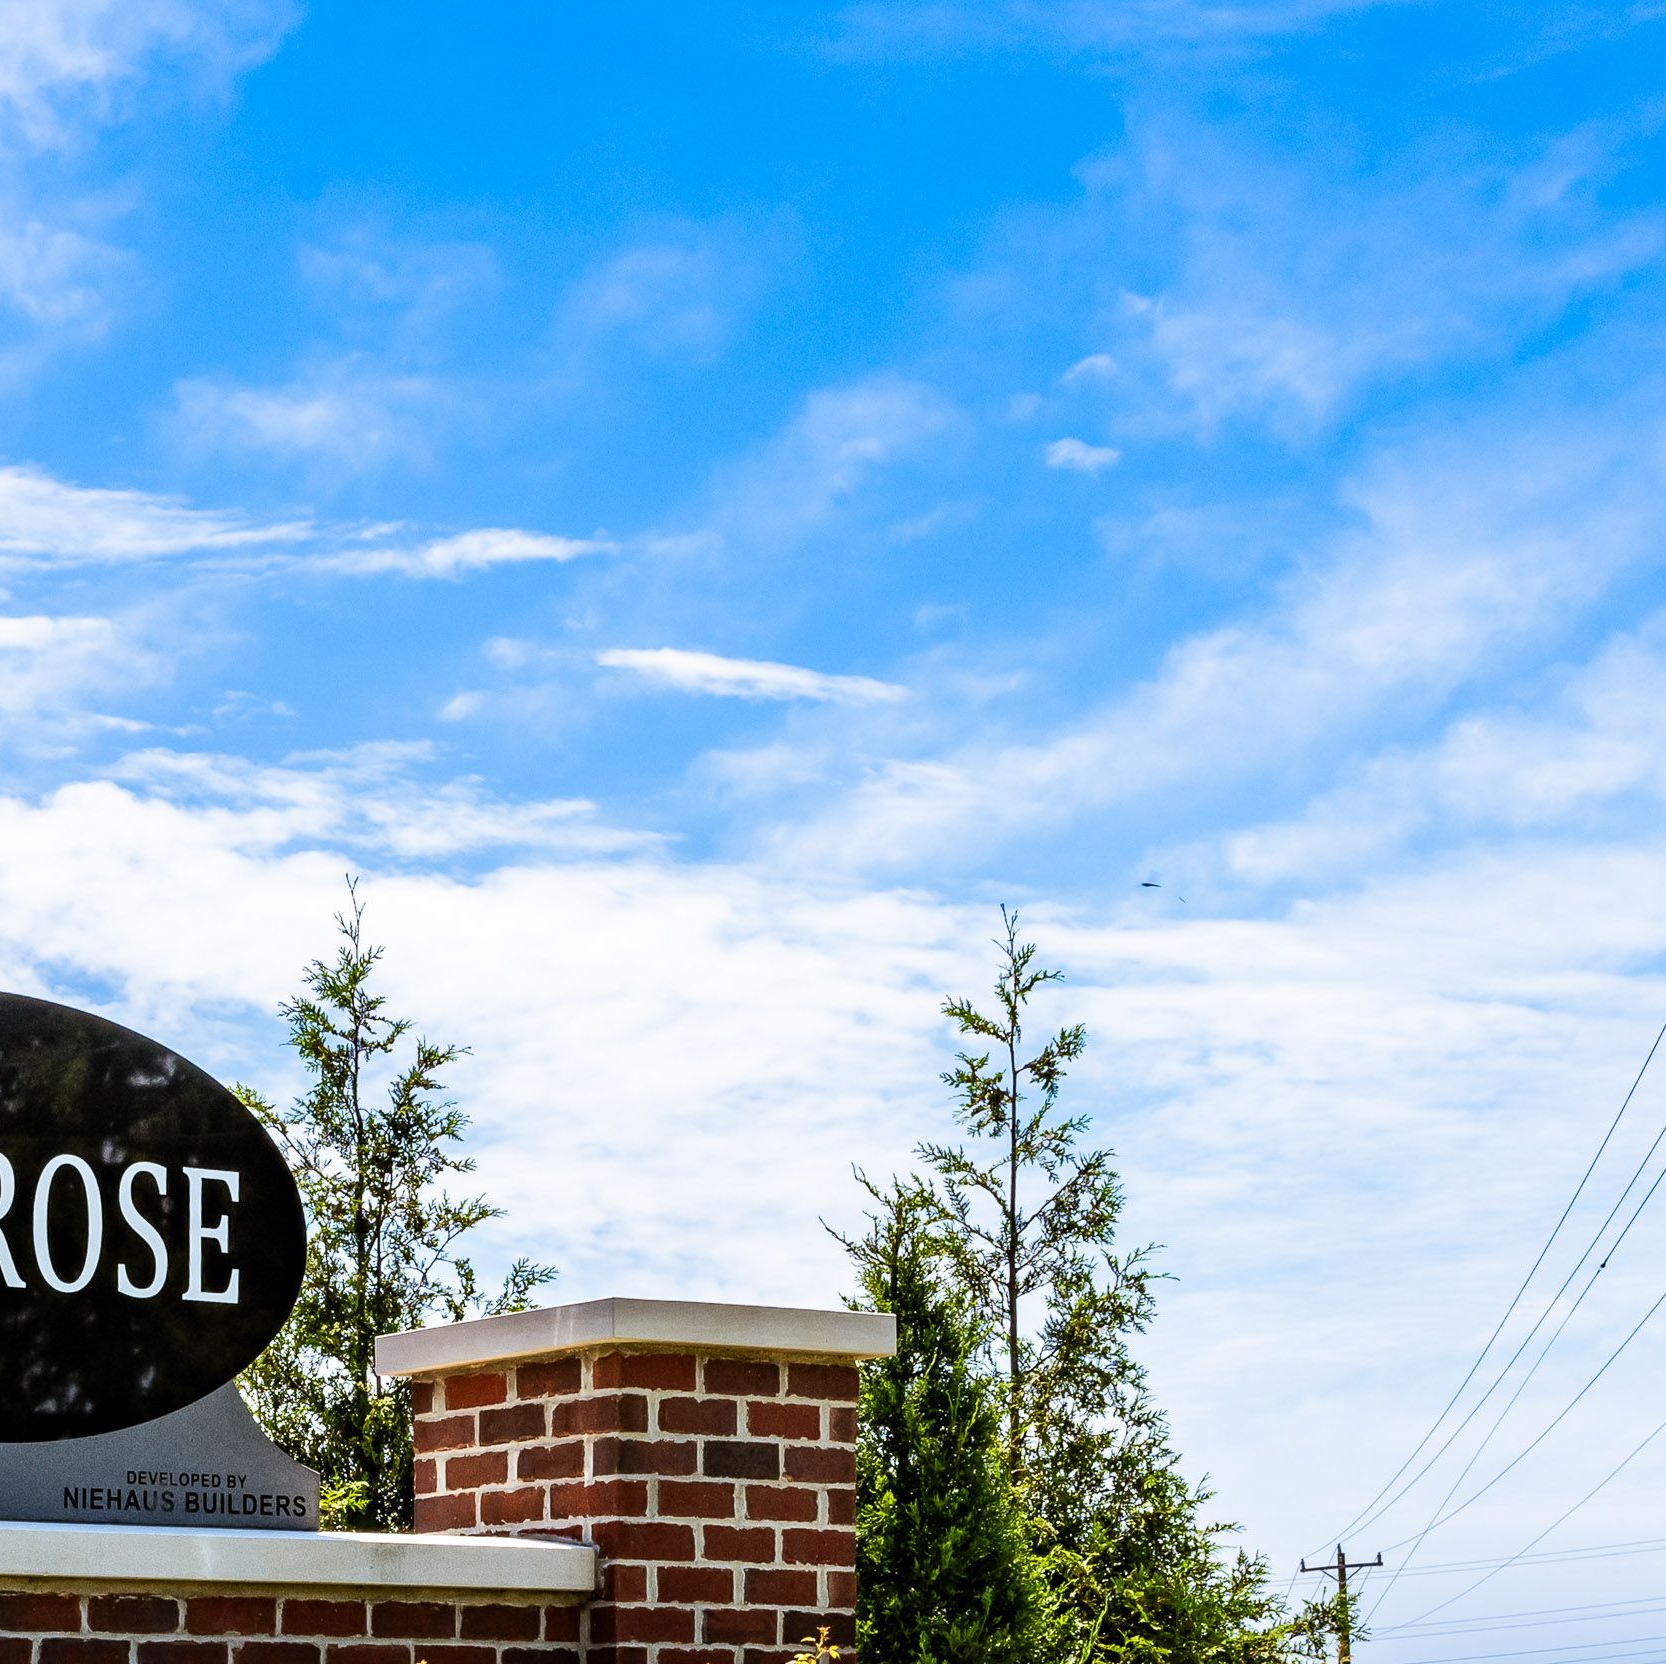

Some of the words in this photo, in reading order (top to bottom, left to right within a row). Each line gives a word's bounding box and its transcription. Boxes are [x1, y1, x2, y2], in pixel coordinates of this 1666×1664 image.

[127, 1471, 221, 1488] DEVELOPED
[227, 1474, 246, 1489] BY
[63, 1487, 174, 1512] NIEHAUS
[185, 1492, 306, 1517] BUILDERS
